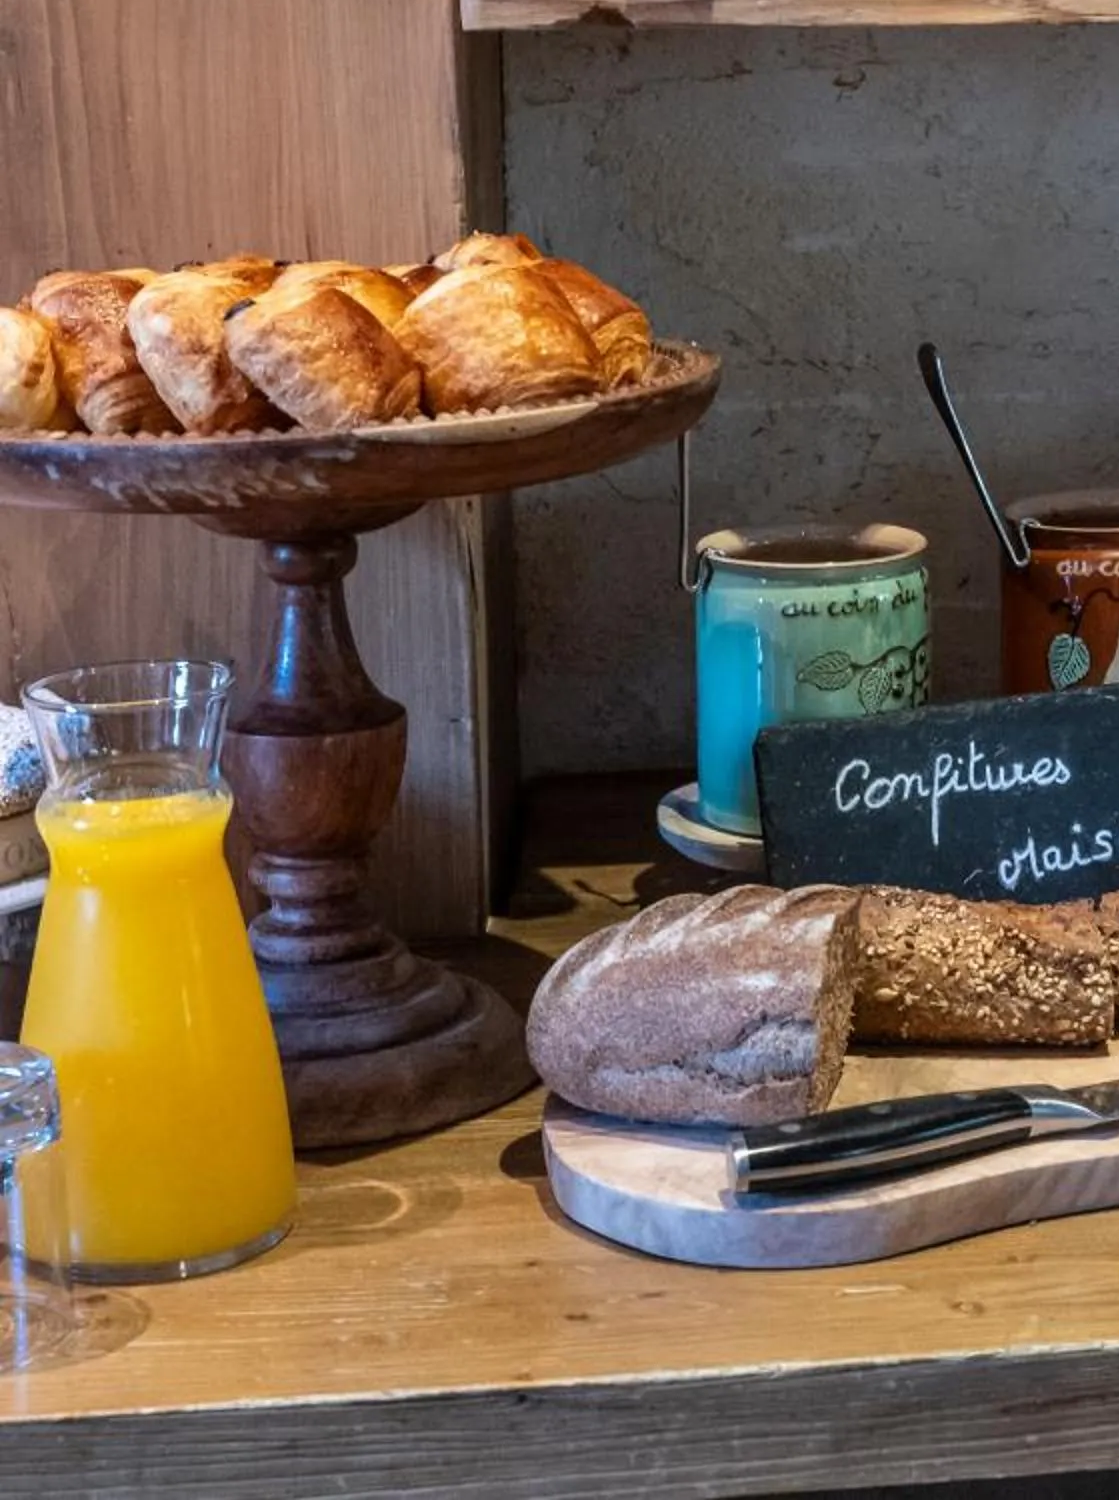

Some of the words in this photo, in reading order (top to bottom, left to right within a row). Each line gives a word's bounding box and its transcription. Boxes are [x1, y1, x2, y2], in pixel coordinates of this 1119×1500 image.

[1055, 557, 1094, 578] au
[780, 598, 821, 618] au
[826, 588, 881, 616] coin
[891, 579, 918, 610] du
[834, 740, 1072, 847] Confitures
